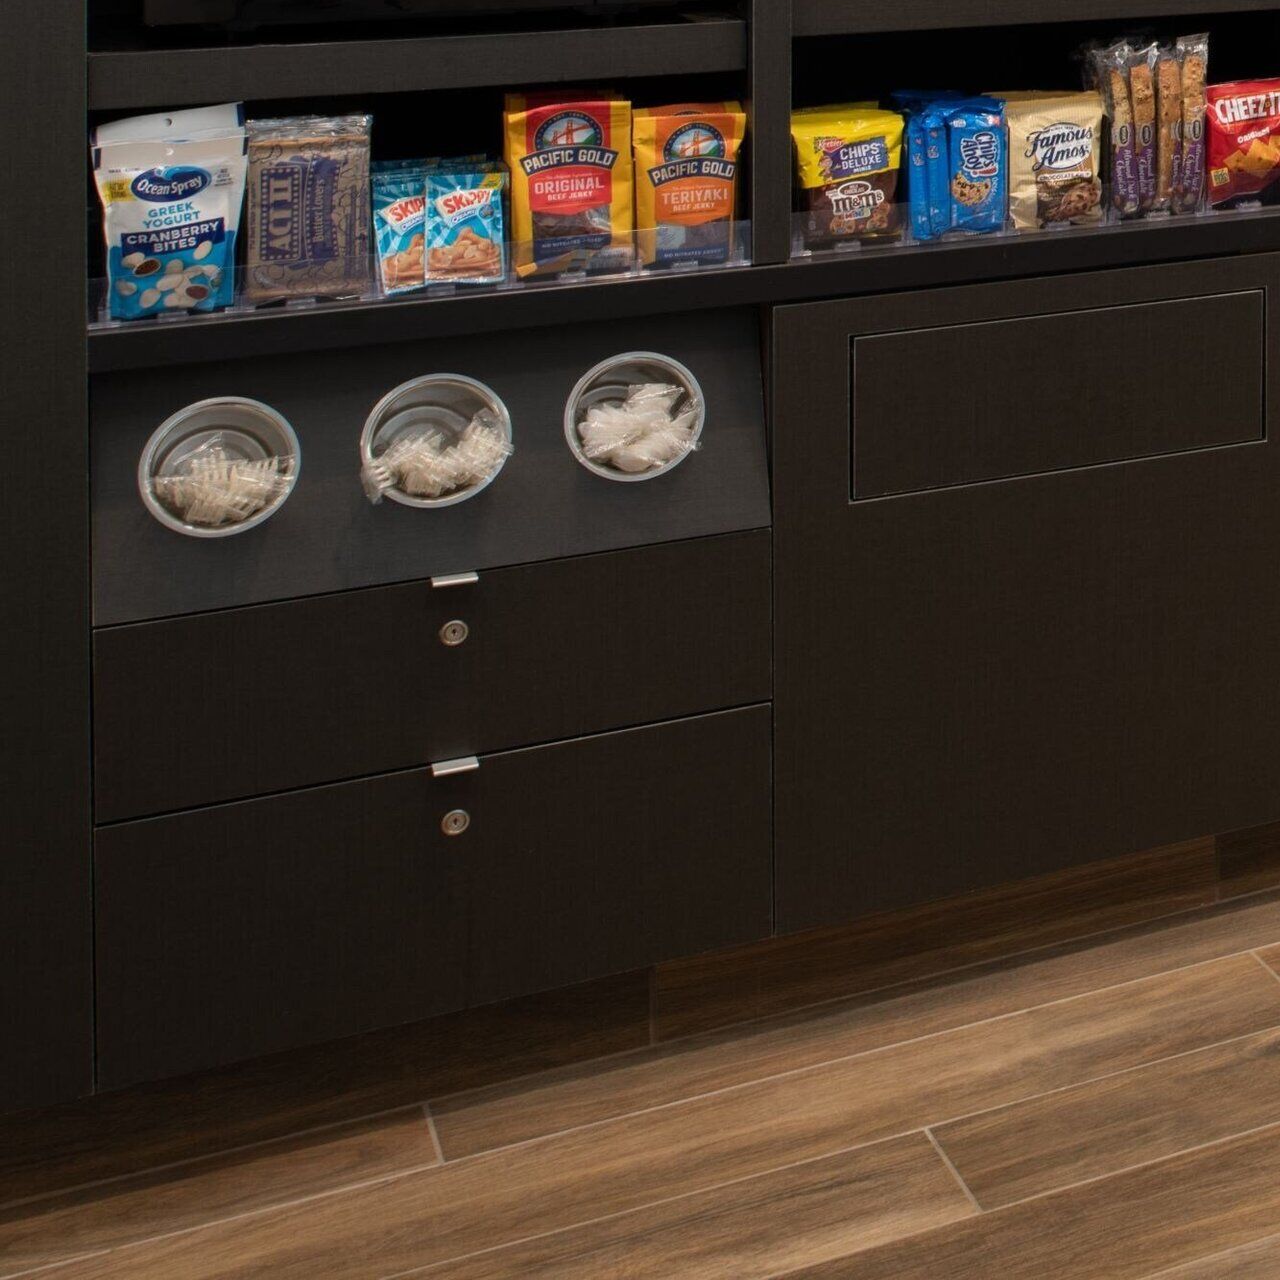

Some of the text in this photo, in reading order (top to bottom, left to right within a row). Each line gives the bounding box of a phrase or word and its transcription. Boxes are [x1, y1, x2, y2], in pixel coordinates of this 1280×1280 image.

[974, 133, 996, 167] Chips
[1025, 127, 1092, 157] Famous
[523, 149, 614, 173] PACIFIC GOLD
[840, 143, 879, 161] CHIPS
[1032, 145, 1089, 171] Amos
[841, 154, 882, 170] DELUXE
[651, 161, 735, 184] PACIFIC GOLD
[137, 179, 170, 195] Ocean
[170, 175, 203, 194] Spray
[534, 176, 605, 194] ORIGINAL
[568, 191, 593, 200] JERKY
[661, 189, 728, 204] TERIYAKI
[148, 201, 195, 218] GREEK
[269, 177, 292, 251] ACT II
[390, 197, 426, 222] SKIP
[672, 201, 716, 212] BEEF JERKY
[142, 211, 201, 228] YOGURT
[127, 222, 219, 244] CRANBERRY
[154, 237, 197, 252] BITES
